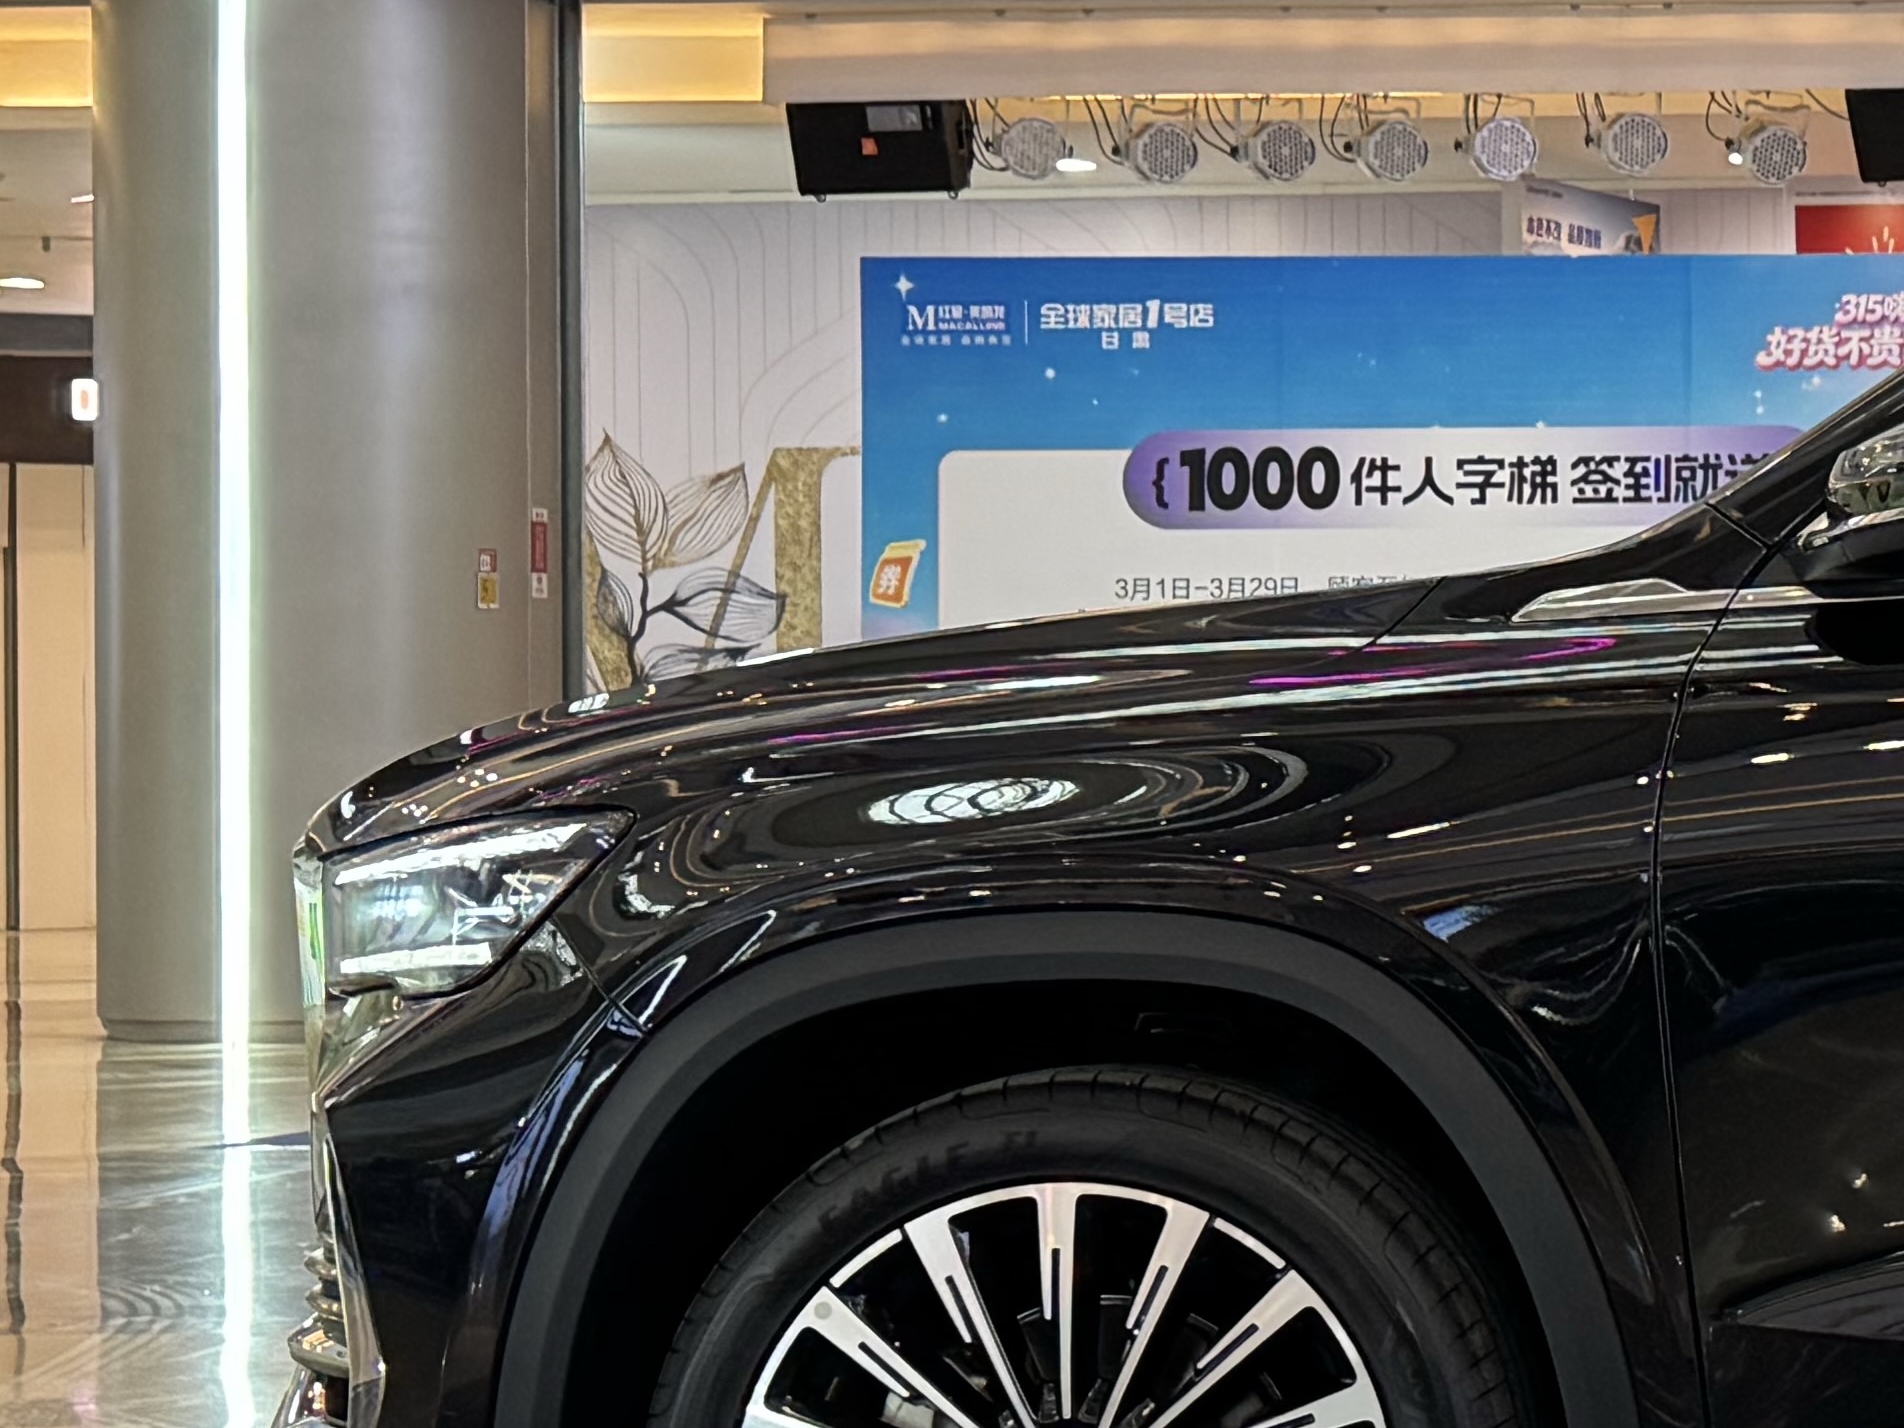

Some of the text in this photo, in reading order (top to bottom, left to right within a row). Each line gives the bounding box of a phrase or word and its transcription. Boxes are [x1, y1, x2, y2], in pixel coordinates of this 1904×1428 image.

[1040, 300, 1214, 329] 全球家居1号店
[1756, 326, 1904, 371] 好货不贵
